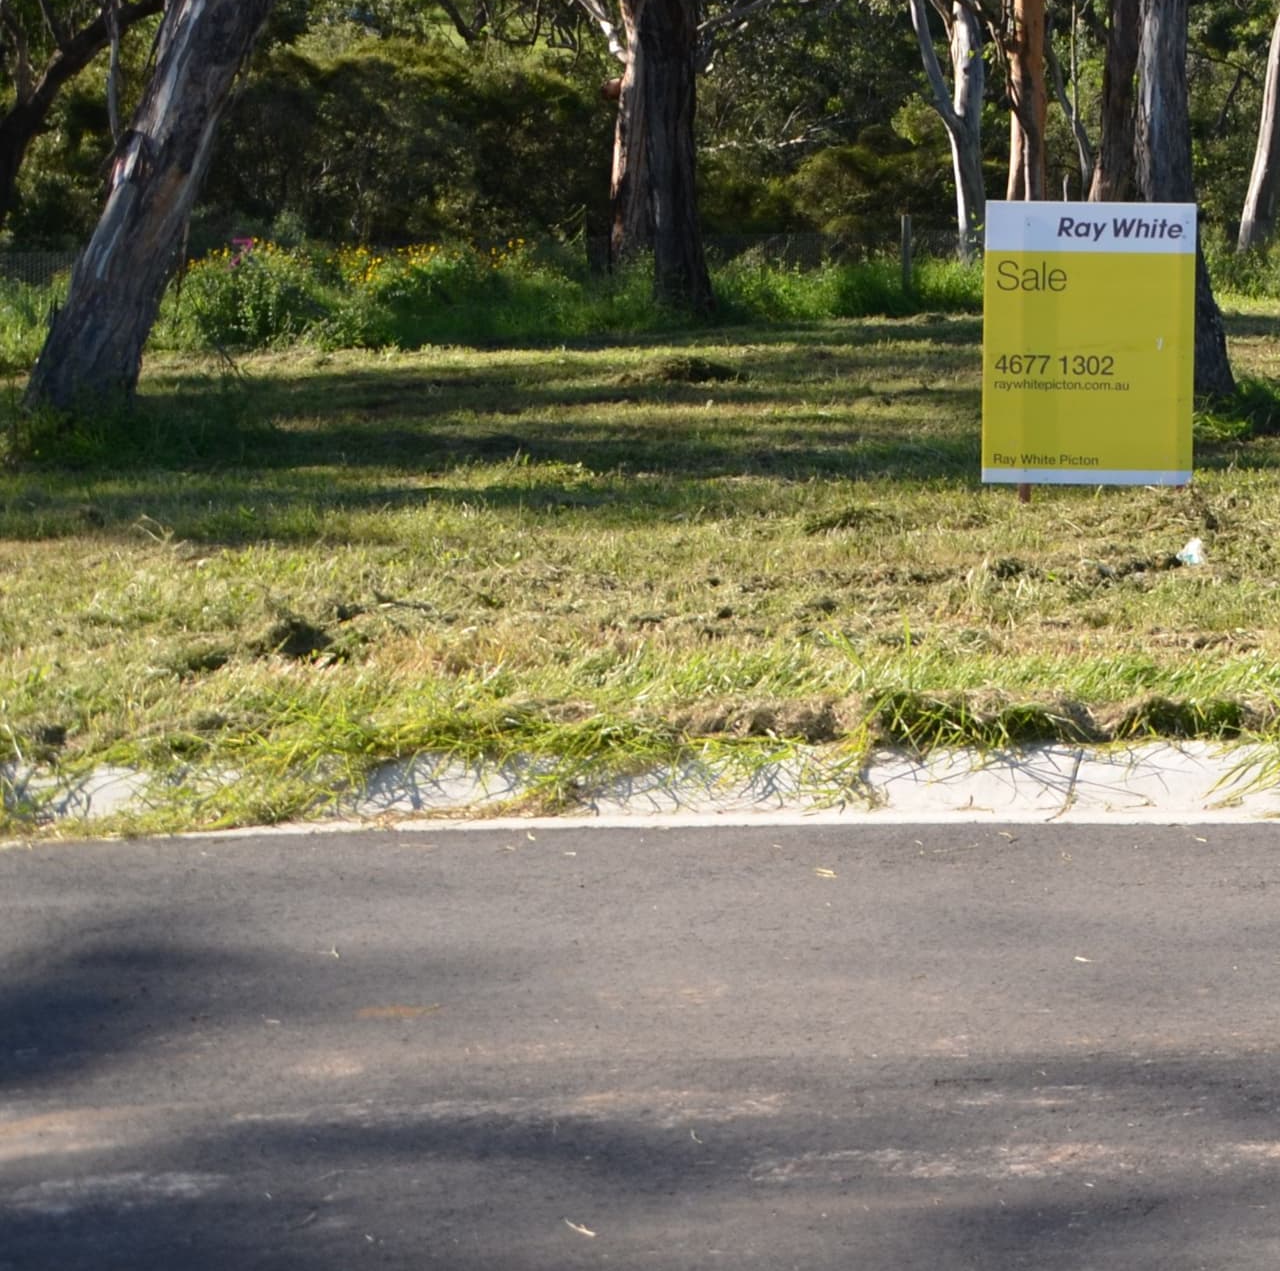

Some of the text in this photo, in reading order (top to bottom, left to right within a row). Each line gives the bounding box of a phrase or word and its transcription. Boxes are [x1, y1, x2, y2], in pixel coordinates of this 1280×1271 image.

[1057, 217, 1183, 241] Ray White
[996, 260, 1067, 292] Sale
[994, 355, 1115, 376] 4677 1302
[994, 379, 1130, 392] raywhitepicton.com.au
[993, 453, 1099, 467] Ray White Picton
